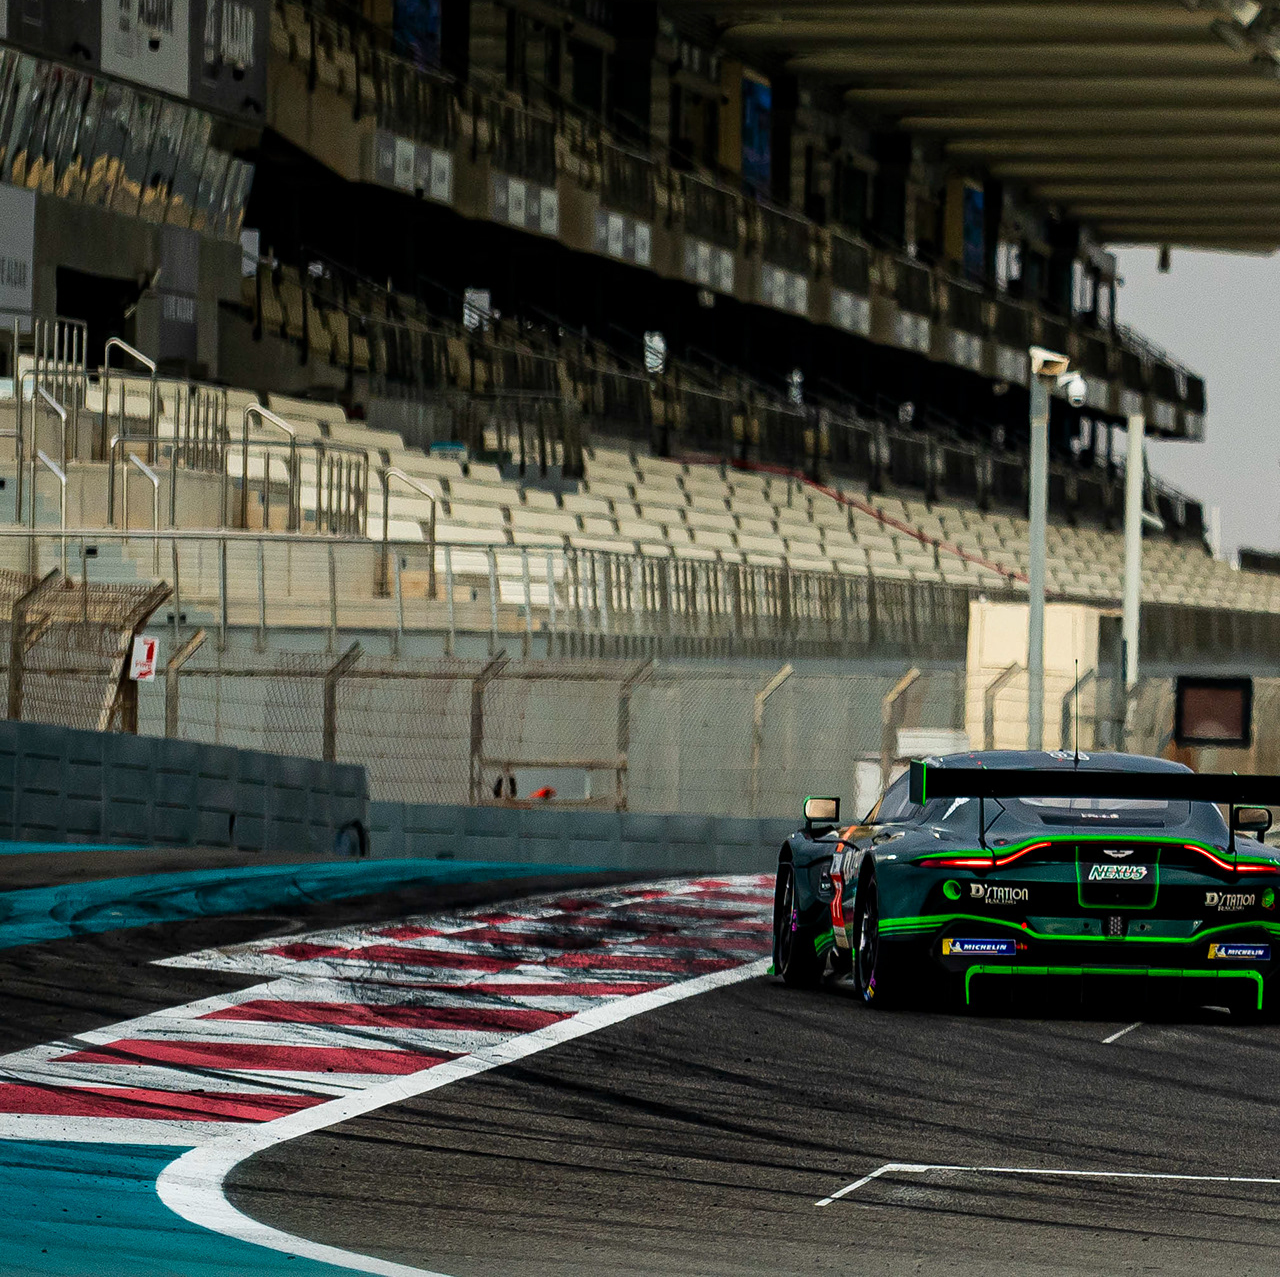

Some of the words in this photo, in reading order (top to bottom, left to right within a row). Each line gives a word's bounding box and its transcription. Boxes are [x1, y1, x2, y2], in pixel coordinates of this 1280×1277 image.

[1088, 864, 1147, 881] NEXUS
[963, 943, 1008, 952] MICHELIN
[1227, 948, 1265, 957] MICHELIN
